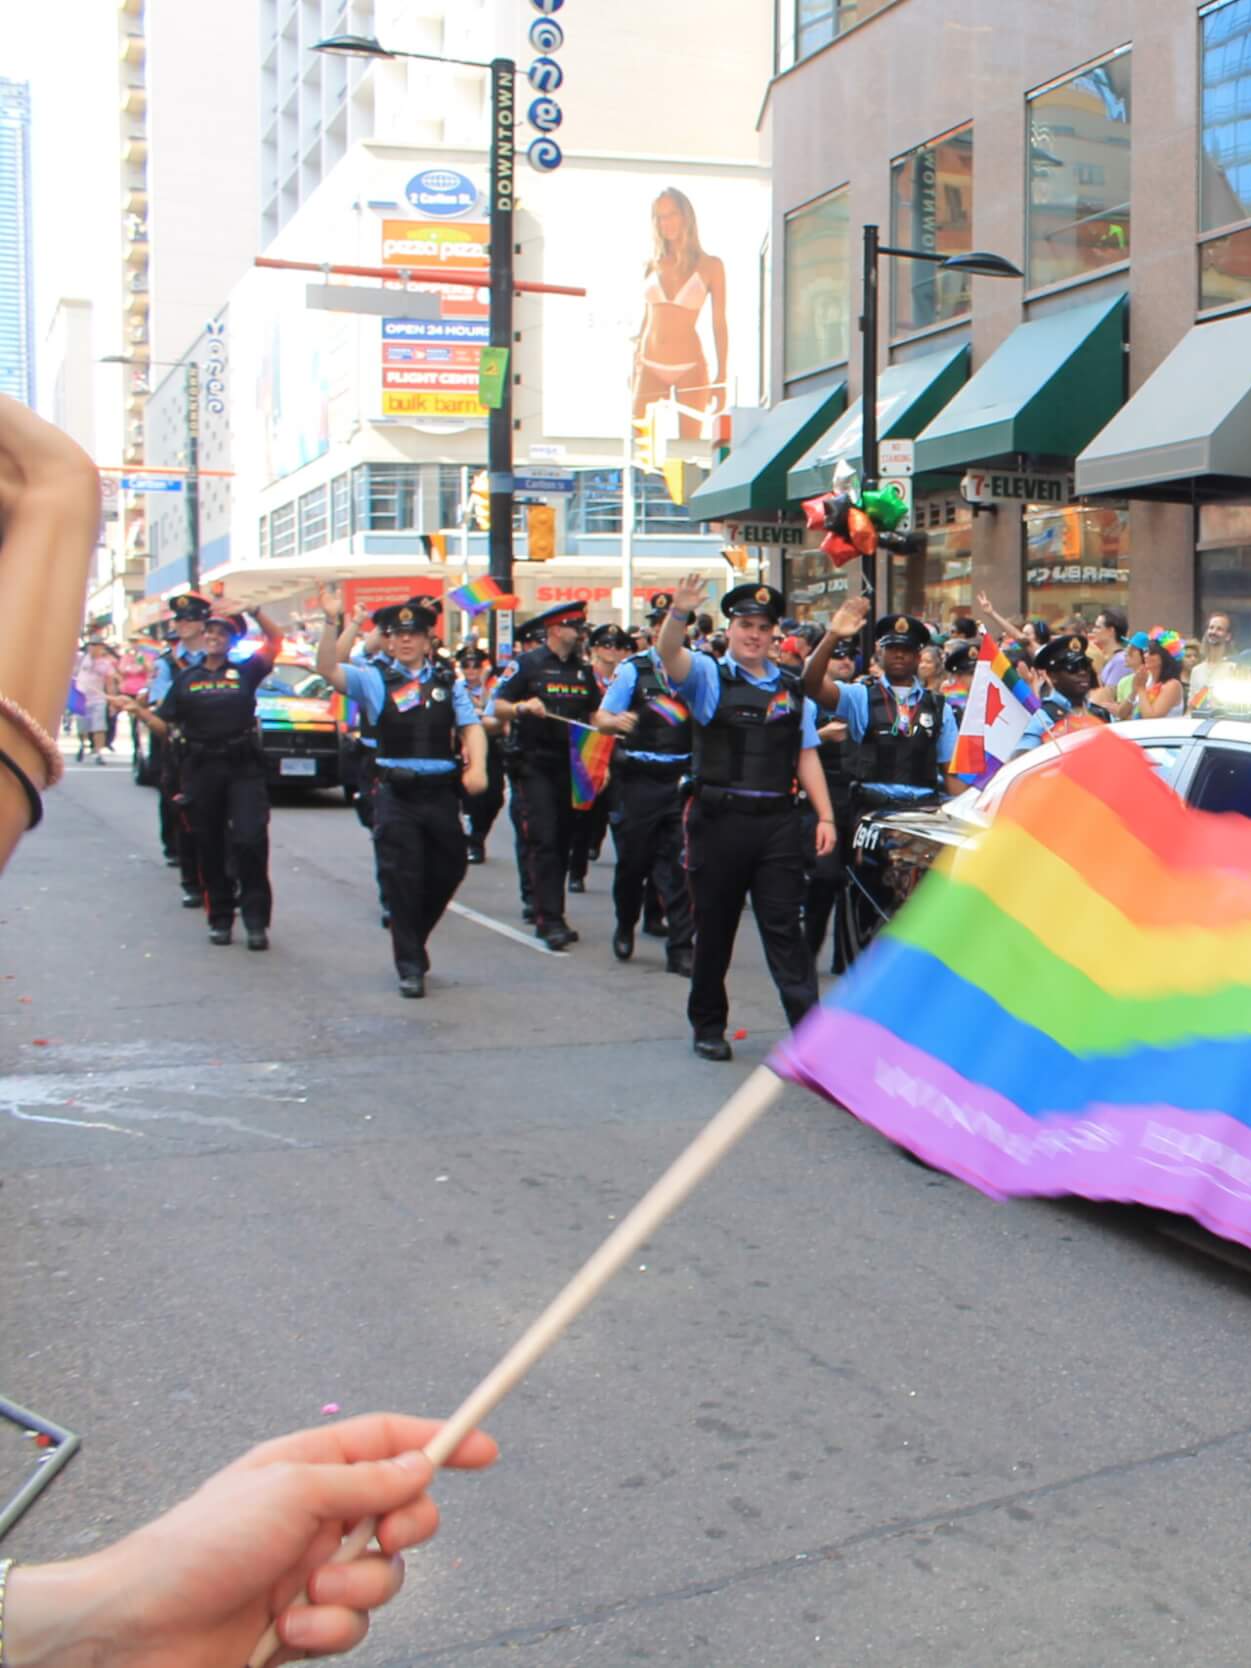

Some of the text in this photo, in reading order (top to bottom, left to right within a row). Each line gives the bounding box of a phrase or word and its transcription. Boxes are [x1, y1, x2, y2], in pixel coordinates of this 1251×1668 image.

[498, 72, 513, 211] DOWNTOWN
[384, 239, 438, 259] pizza
[385, 324, 425, 335] OPEN
[427, 325, 443, 335] 24
[386, 371, 438, 383] FLIGHT
[388, 393, 477, 411] bulk barn
